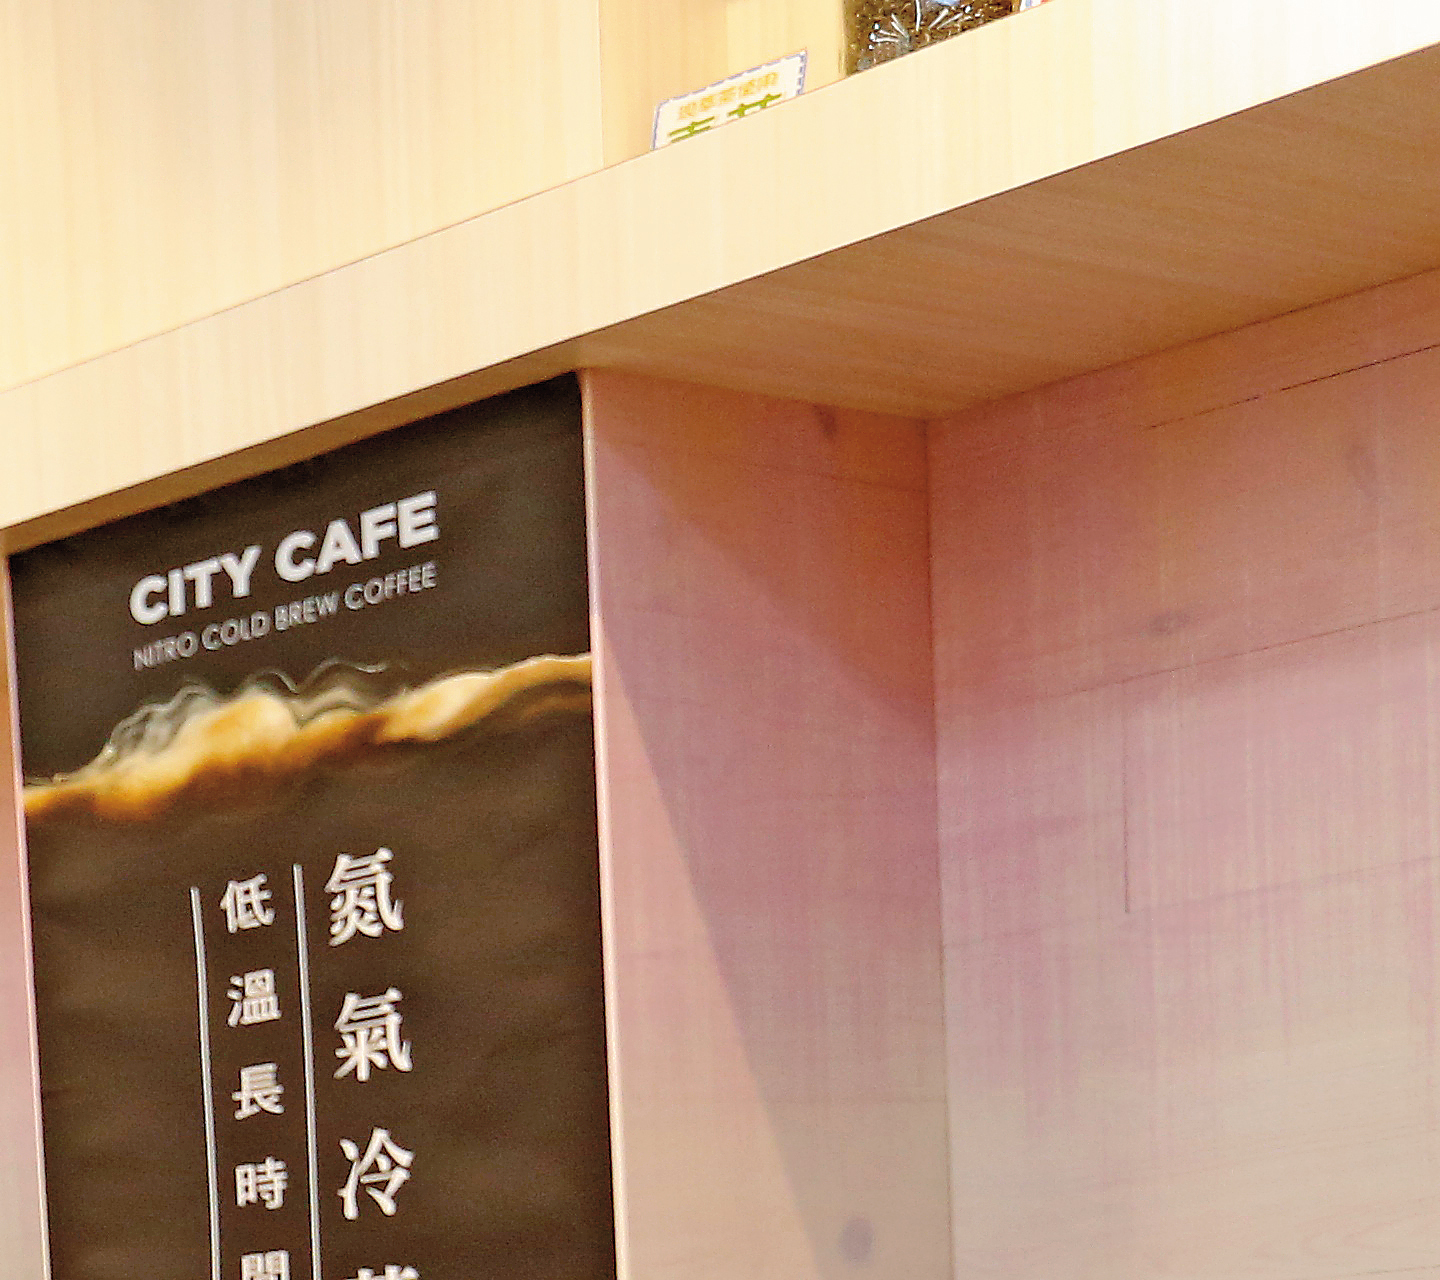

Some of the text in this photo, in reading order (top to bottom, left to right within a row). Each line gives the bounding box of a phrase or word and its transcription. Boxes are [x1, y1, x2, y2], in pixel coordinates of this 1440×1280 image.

[128, 490, 440, 627] CITY CAFE
[133, 560, 437, 671] NITRO COLD BREW COFFEE
